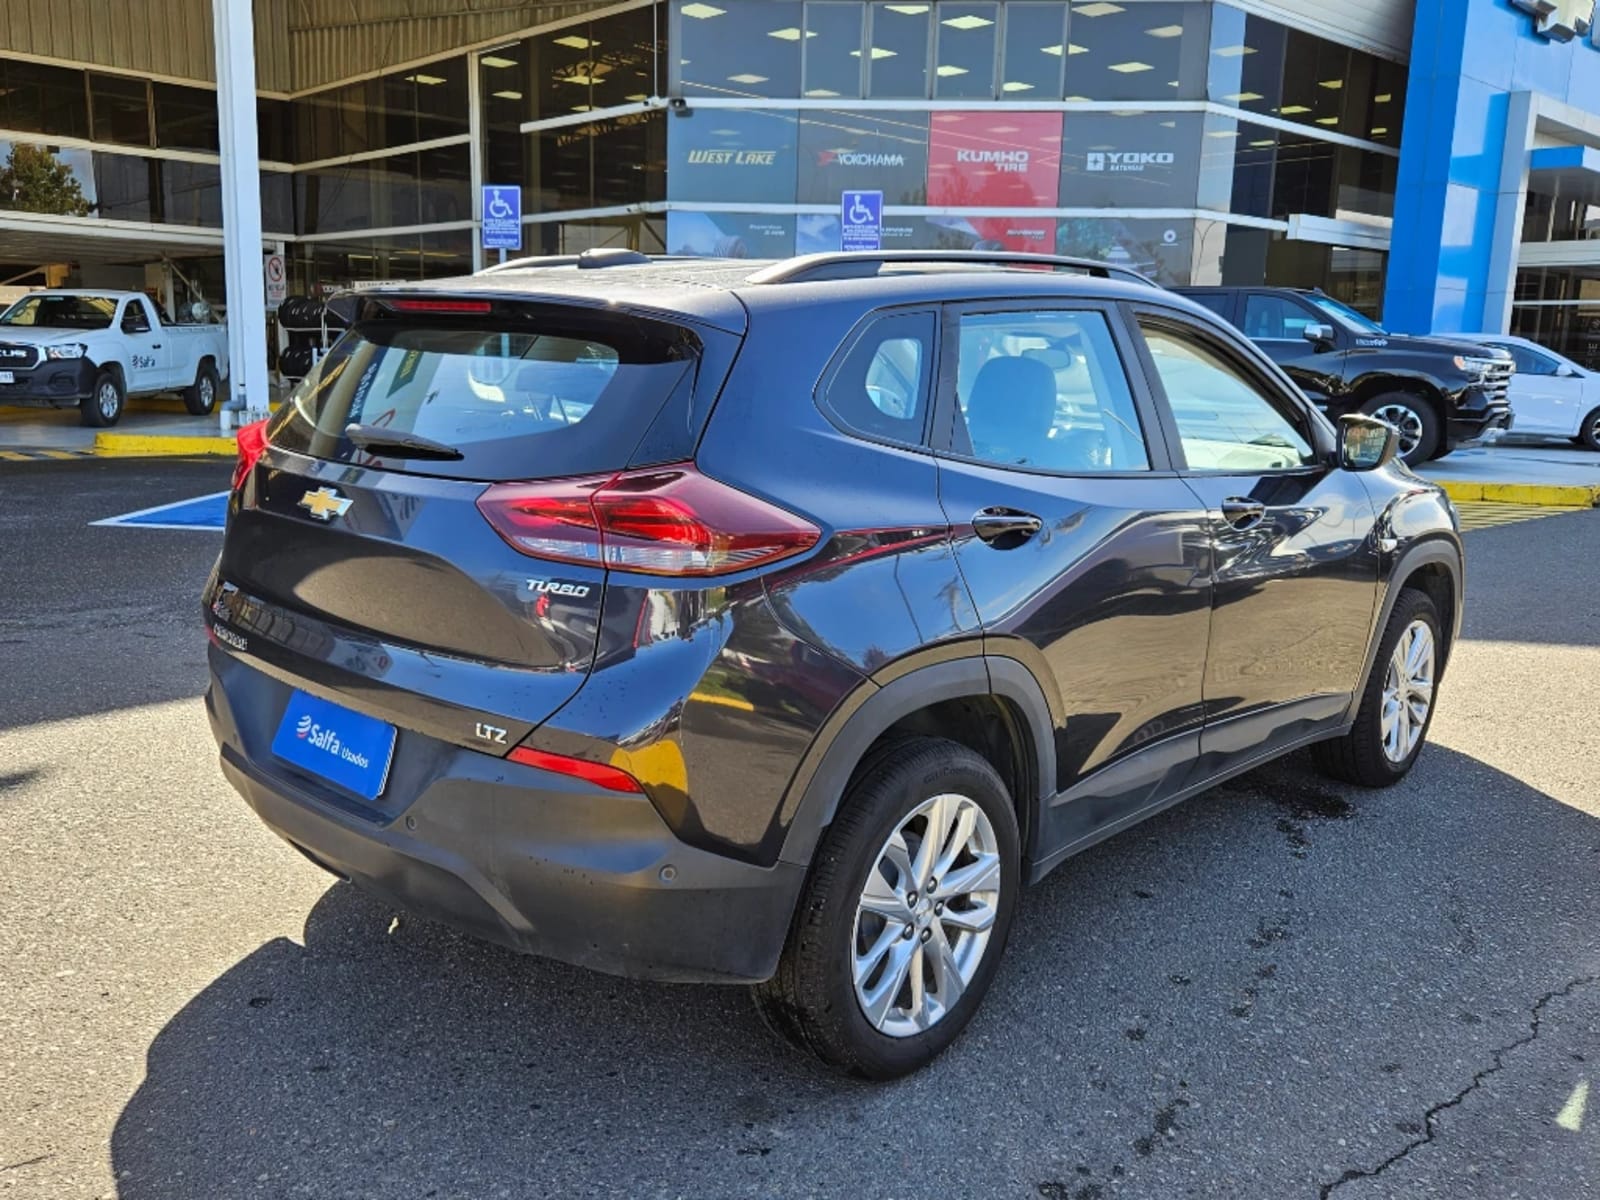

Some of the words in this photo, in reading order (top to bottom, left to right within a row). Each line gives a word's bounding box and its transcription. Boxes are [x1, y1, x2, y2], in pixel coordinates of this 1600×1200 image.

[688, 151, 732, 164] WEST
[735, 151, 776, 165] LAKE
[837, 153, 904, 166] YOKOHAMA
[957, 150, 1029, 162] KUMHO
[1106, 153, 1174, 163] YOKO
[994, 163, 1028, 172] TIRE
[526, 578, 590, 598] TURBO
[476, 722, 507, 745] LTZ
[308, 724, 341, 755] Salfa
[341, 747, 369, 769] Usados
